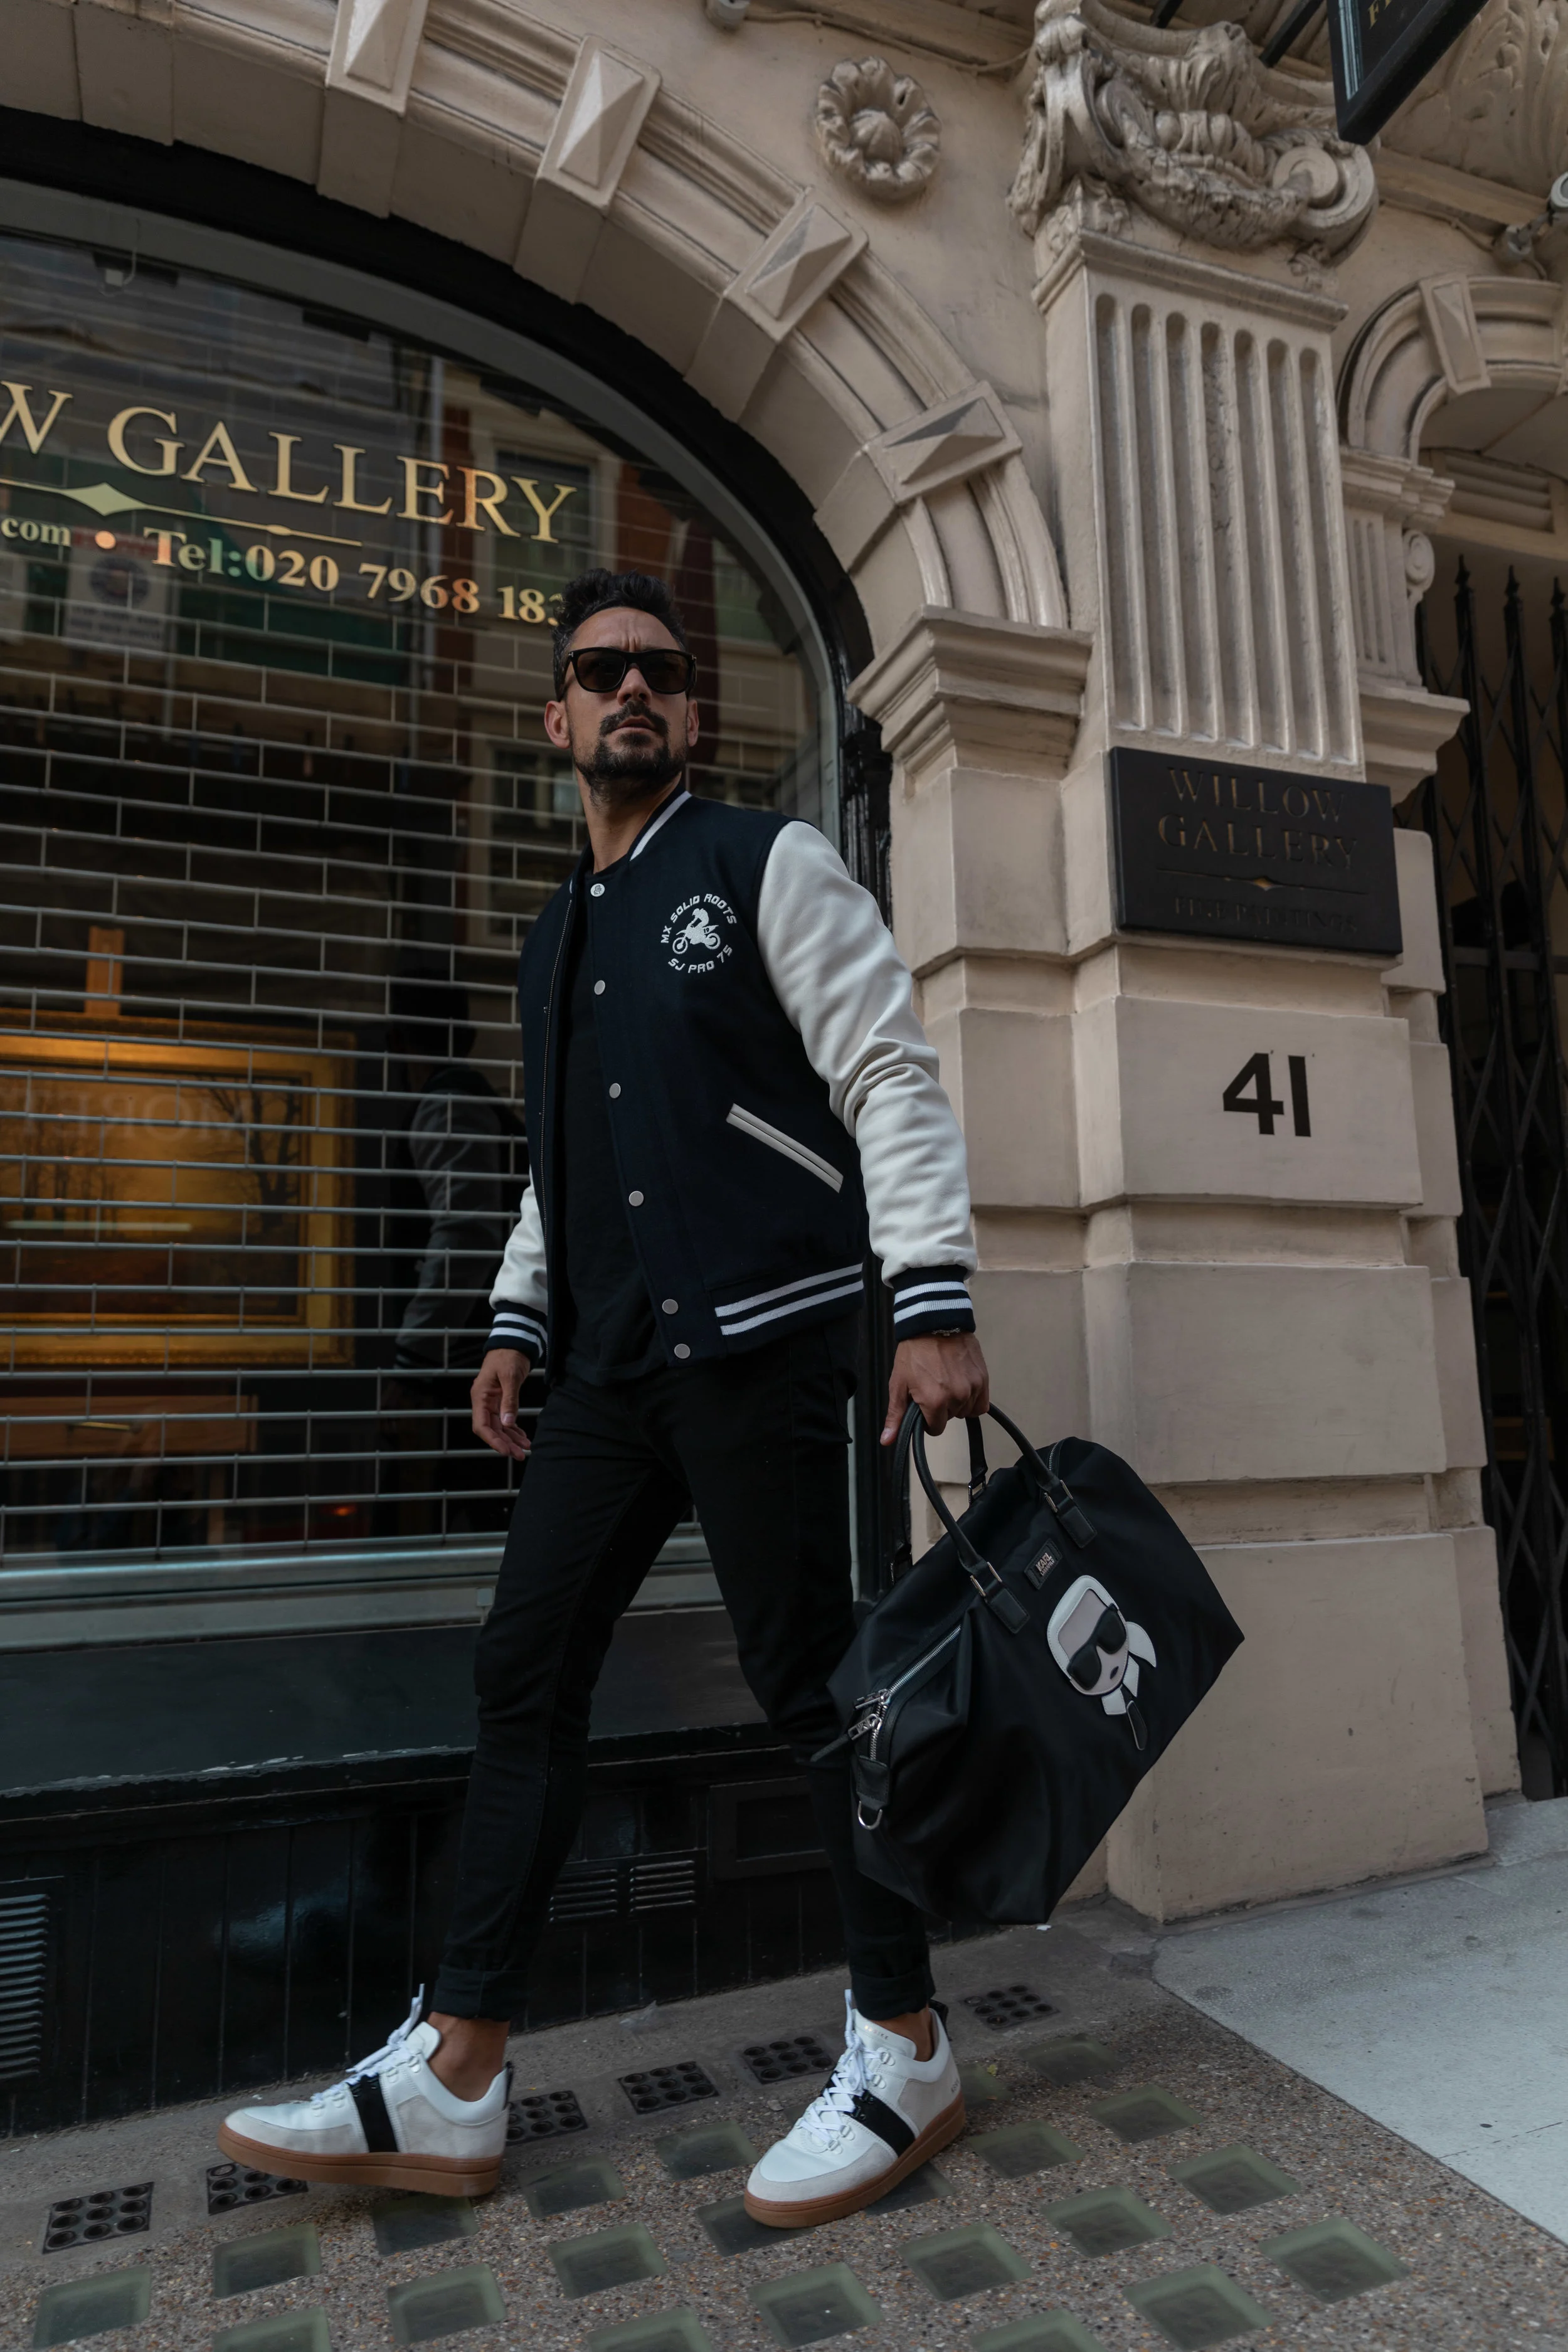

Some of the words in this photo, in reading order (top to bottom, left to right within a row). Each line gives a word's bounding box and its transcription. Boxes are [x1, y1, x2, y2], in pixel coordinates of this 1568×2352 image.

[107, 406, 578, 543] GALLERY
[1, 517, 71, 547] com
[359, 562, 480, 613] 7968
[1167, 766, 1345, 822] WILLOW
[1158, 813, 1359, 870] GALLERY
[660, 925, 672, 943] MX
[670, 895, 700, 923] SOLID
[704, 893, 737, 924] ROOTS
[668, 958, 686, 971] SJ
[687, 960, 715, 973] PRO
[716, 945, 733, 963] 75
[1222, 1052, 1311, 1137] 41
[1035, 1552, 1052, 1572] KARL
